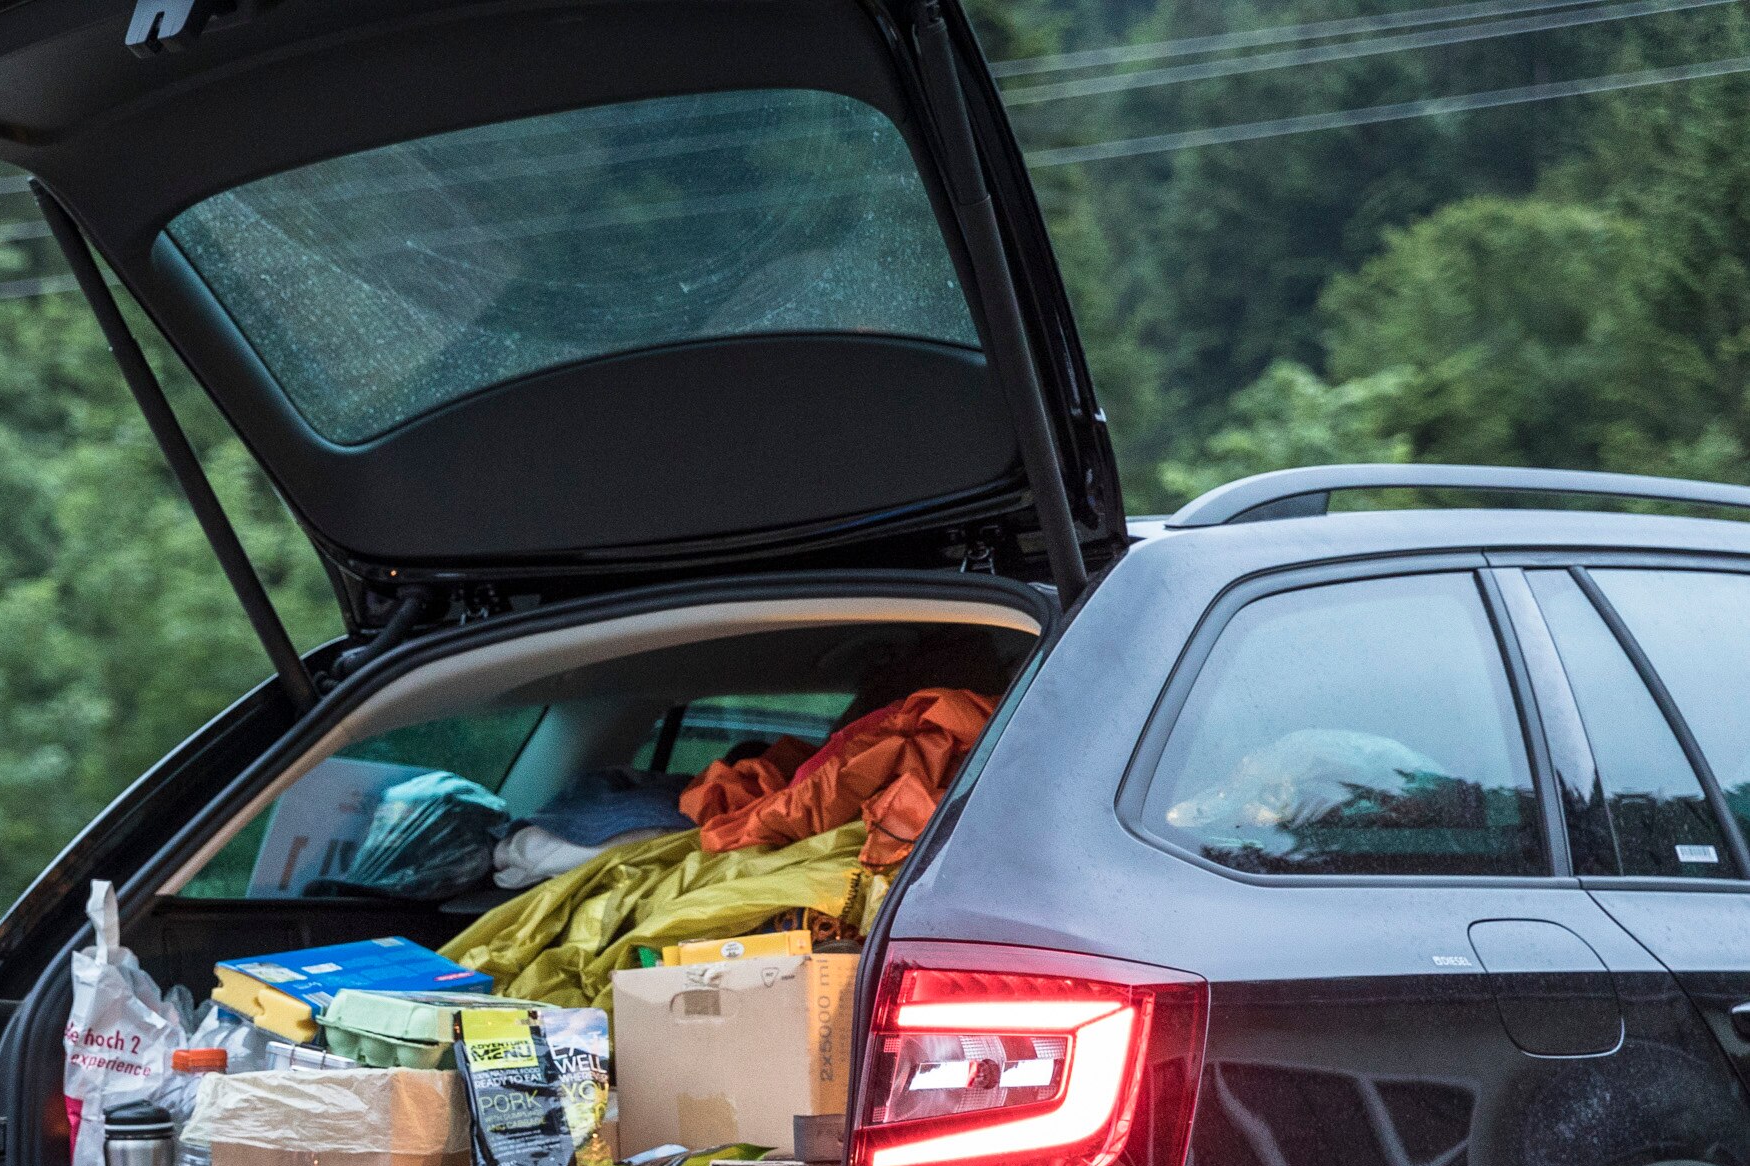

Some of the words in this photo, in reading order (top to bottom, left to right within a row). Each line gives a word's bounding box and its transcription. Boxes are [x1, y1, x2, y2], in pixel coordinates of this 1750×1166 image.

[84, 1028, 125, 1051] hoch
[131, 1035, 142, 1055] 2
[470, 1040, 529, 1051] ADVENTURE
[471, 1045, 532, 1062] MENU
[553, 1053, 608, 1074] WELL
[71, 1053, 152, 1077] experience
[474, 1077, 507, 1089] READY
[507, 1073, 524, 1085] TO
[479, 1089, 543, 1115] PORK
